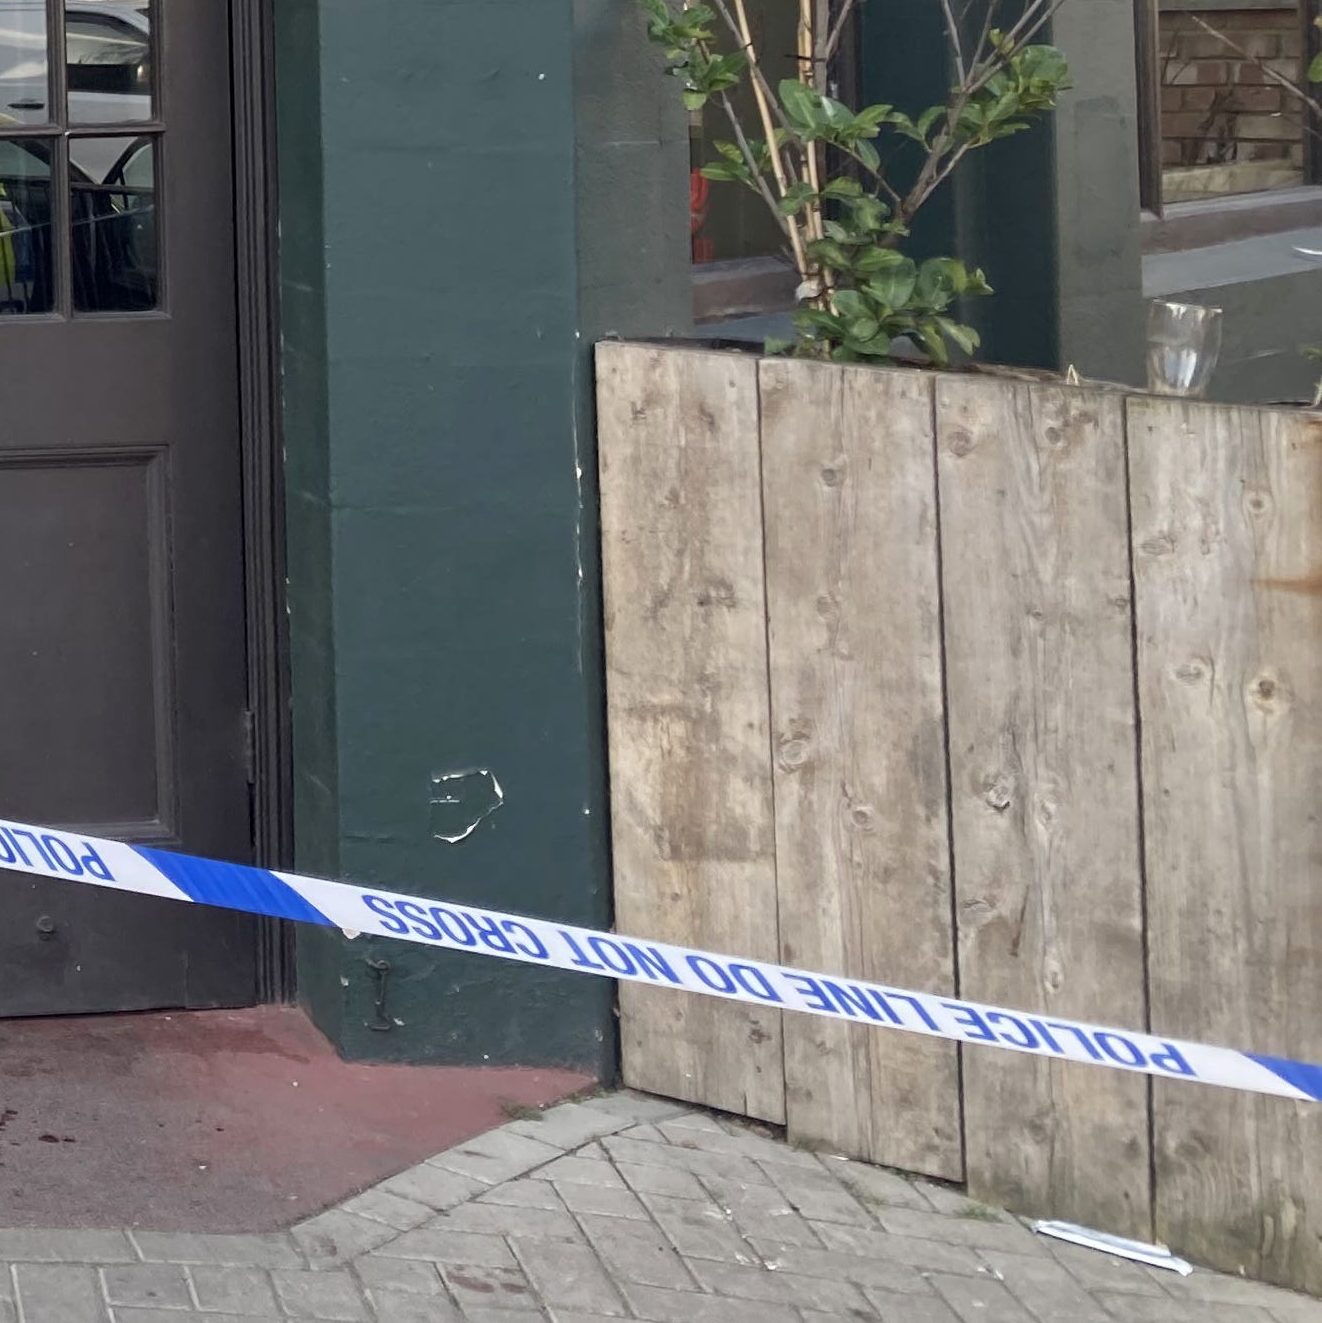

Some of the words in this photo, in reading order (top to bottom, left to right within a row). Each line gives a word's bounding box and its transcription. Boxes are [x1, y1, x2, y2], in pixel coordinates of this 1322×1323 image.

[361, 893, 551, 961] CROSS
[559, 930, 684, 985] NOT
[684, 954, 783, 1003] DO
[782, 973, 940, 1032] LINE
[943, 1003, 1196, 1077] POLICE
